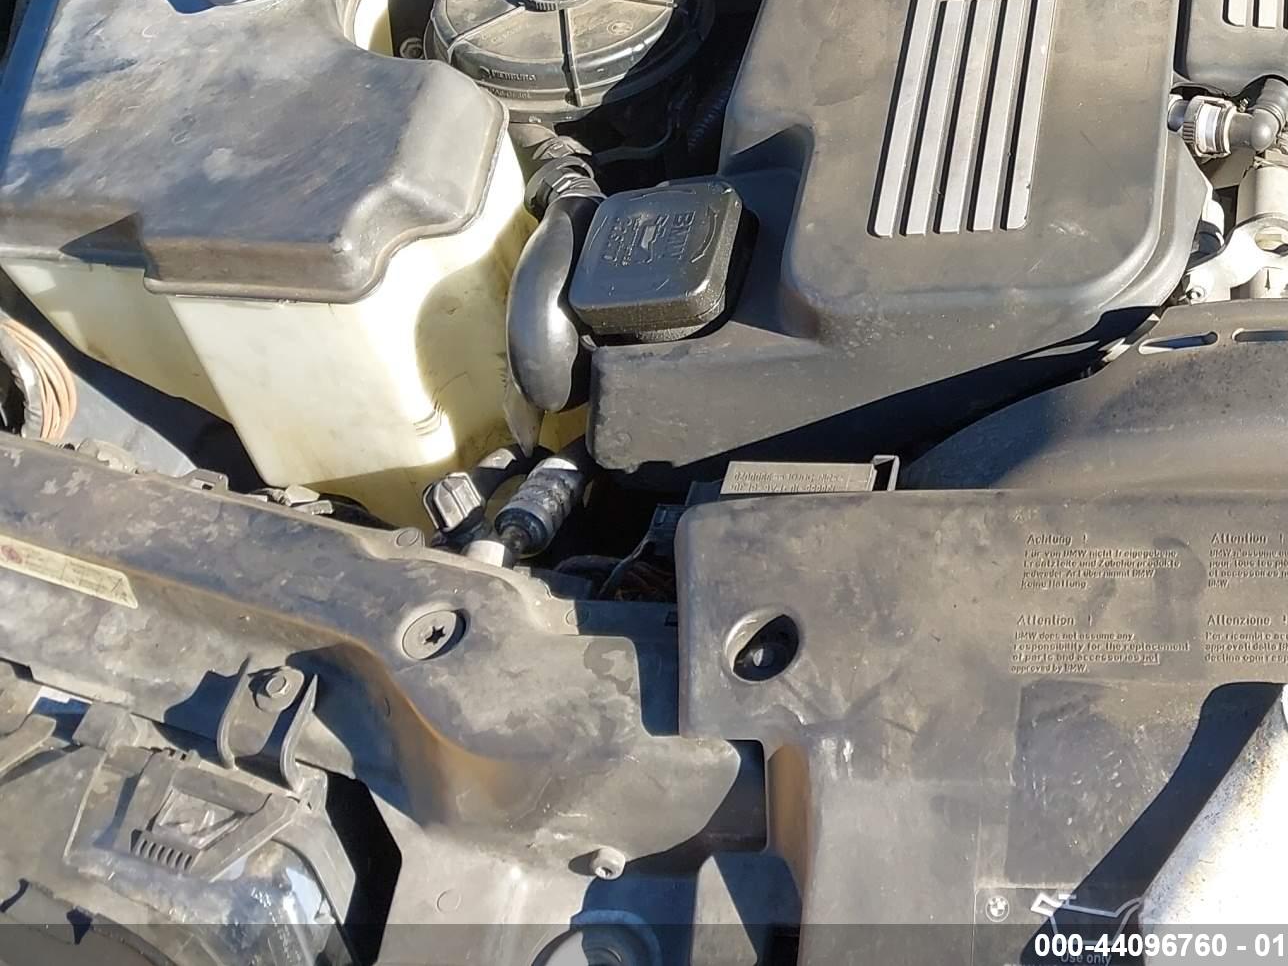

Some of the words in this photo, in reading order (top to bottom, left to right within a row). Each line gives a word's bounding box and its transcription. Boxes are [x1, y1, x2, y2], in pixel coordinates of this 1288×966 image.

[1026, 534, 1072, 546] Achtung
[1211, 533, 1268, 544] Attention
[1016, 615, 1074, 626] Attention
[1208, 615, 1271, 626] Attenzione
[1015, 632, 1038, 640] BMW
[1117, 633, 1134, 641] any
[1013, 642, 1083, 651] responsibility
[1087, 642, 1102, 650] for
[1105, 642, 1122, 650] the
[1124, 642, 1190, 652] replacement
[1057, 653, 1075, 661] and
[1077, 654, 1140, 662] accessories
